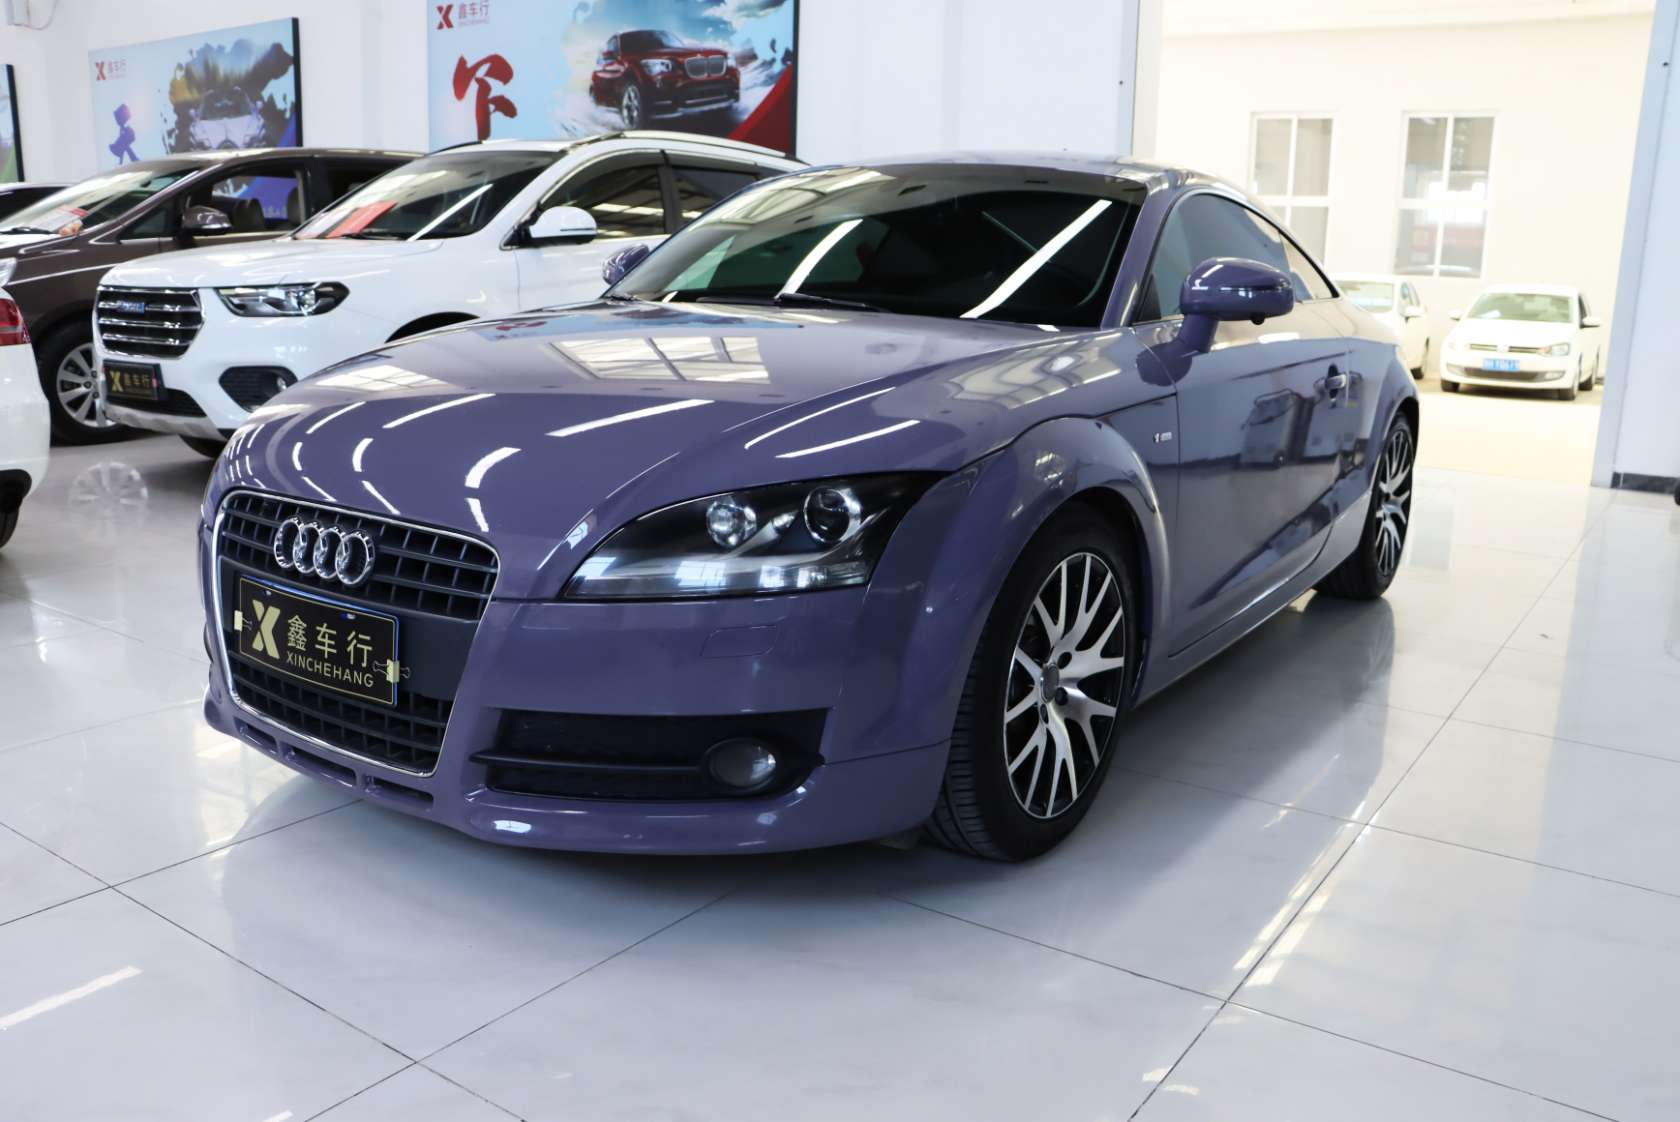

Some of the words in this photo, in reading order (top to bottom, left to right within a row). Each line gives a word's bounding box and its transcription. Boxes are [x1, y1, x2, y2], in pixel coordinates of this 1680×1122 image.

[287, 614, 373, 668] 鑫车行
[286, 650, 374, 688] XINCHEHANG
